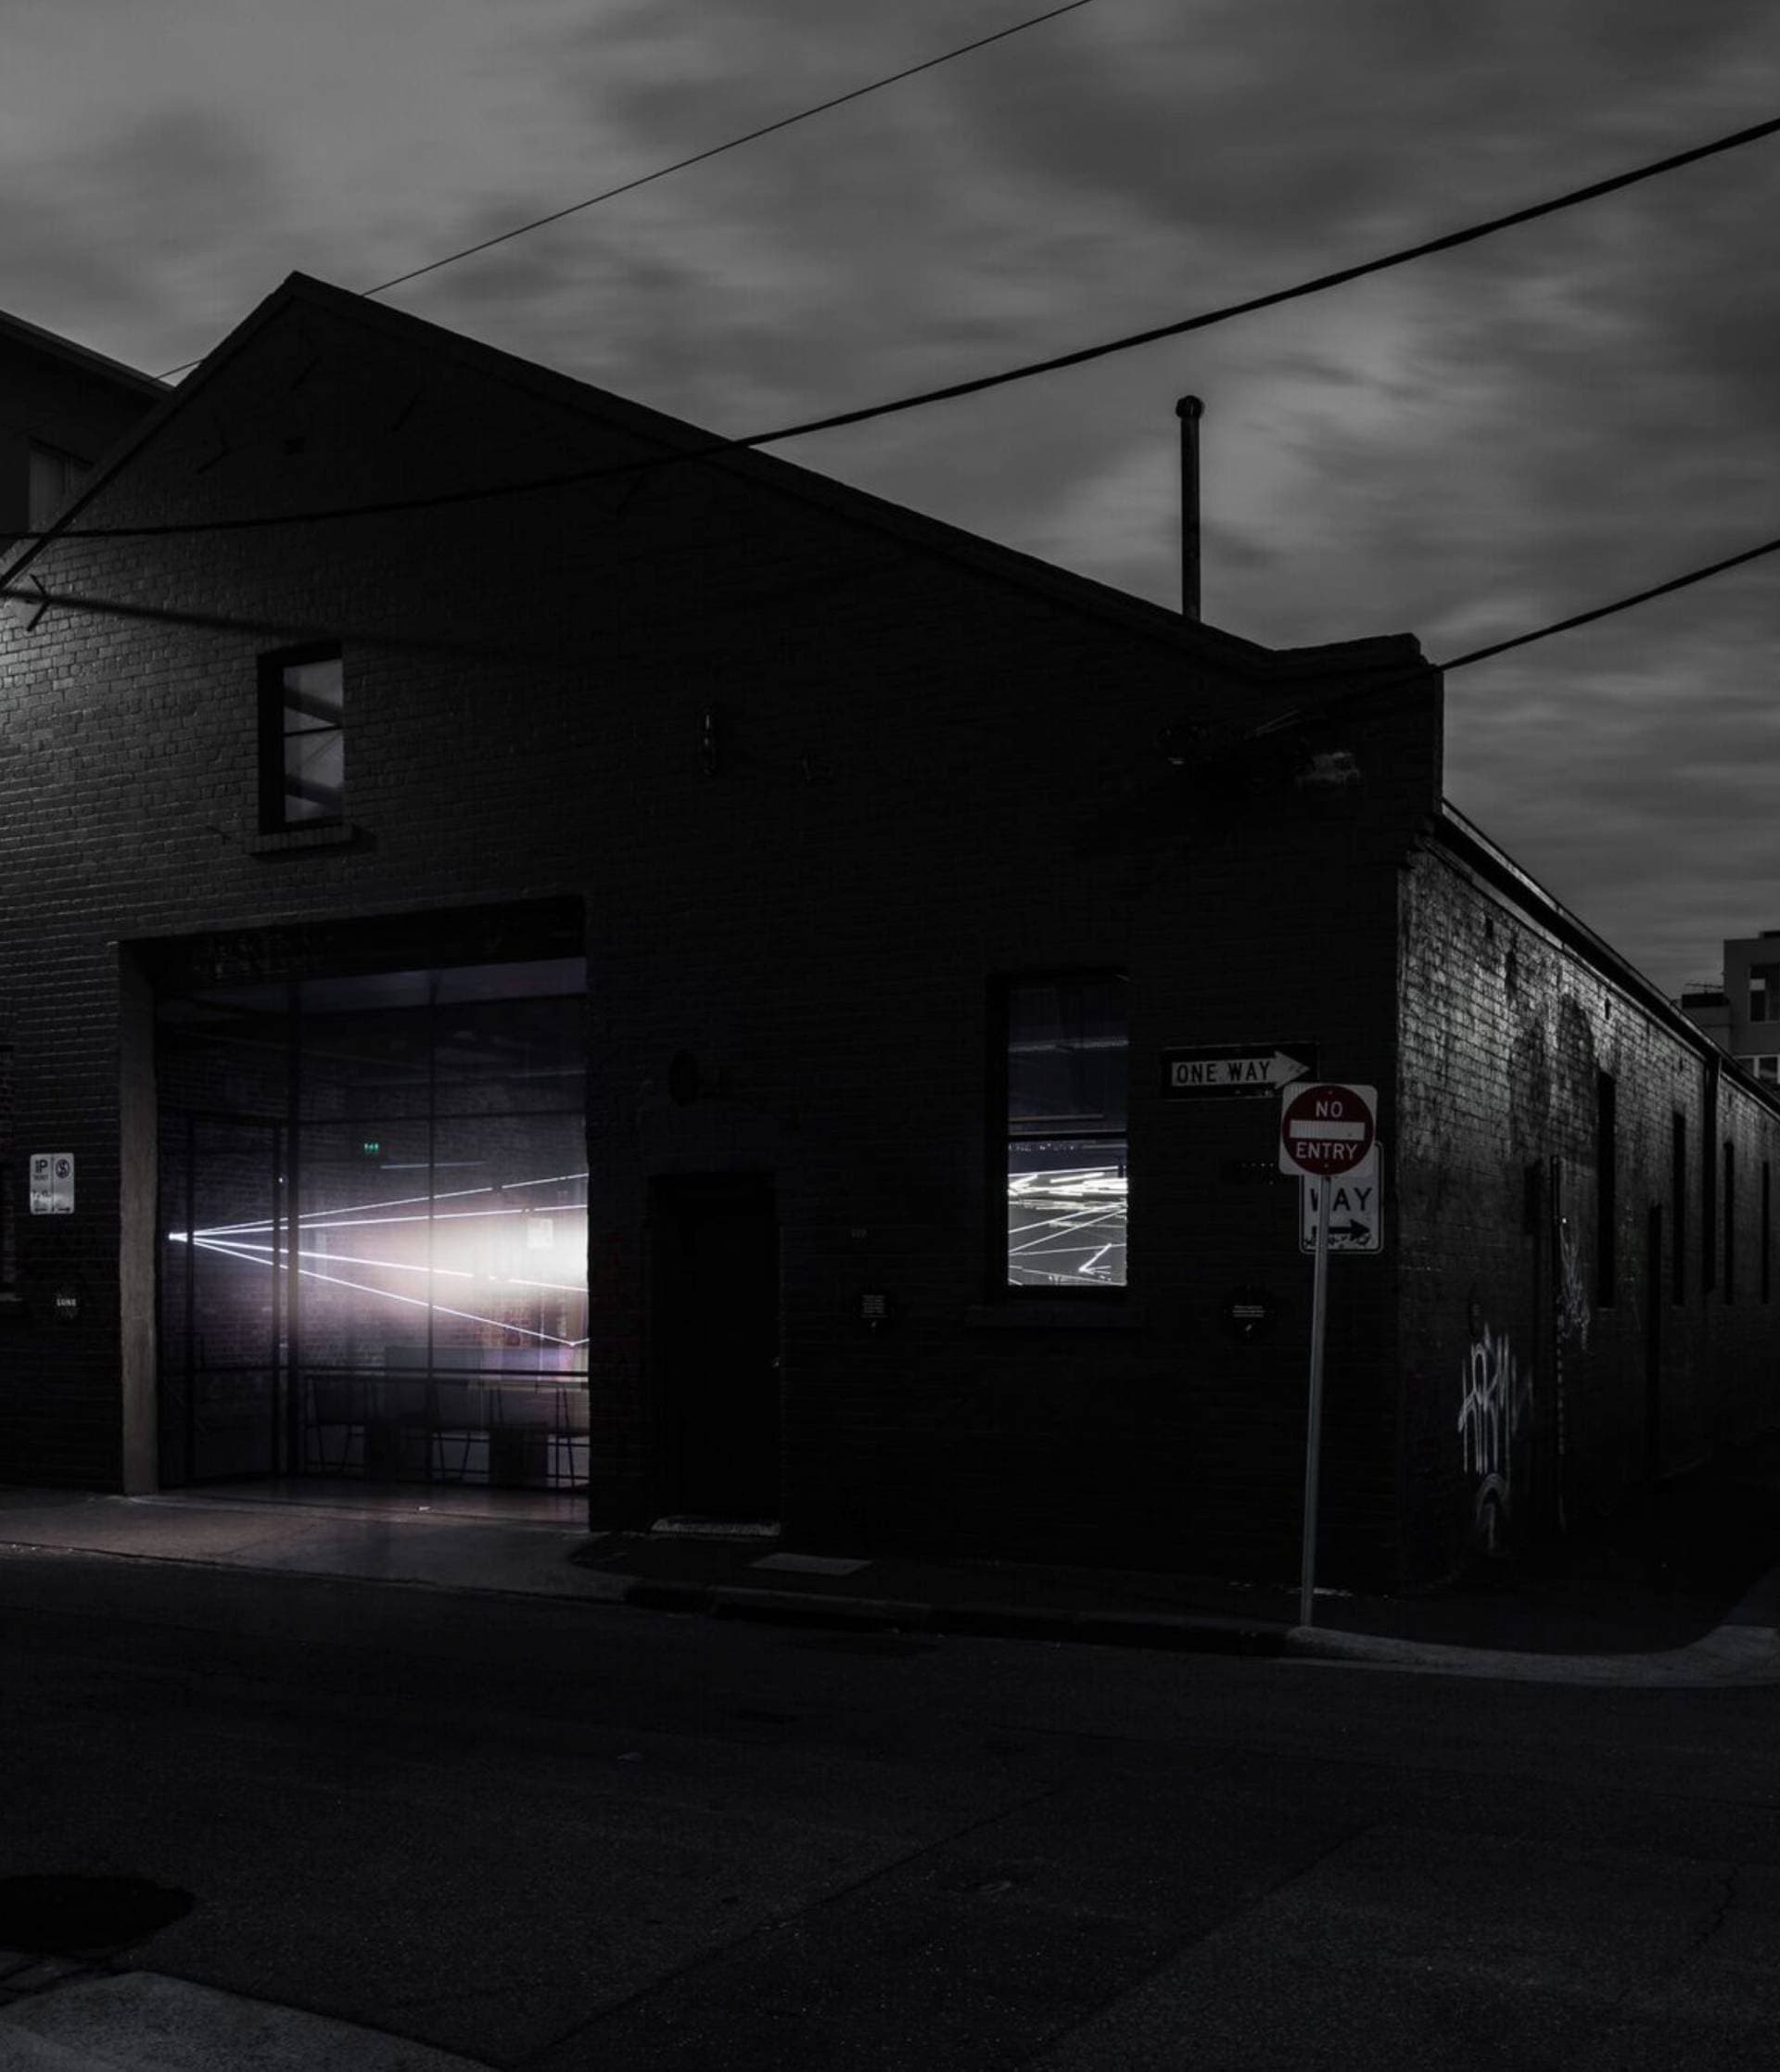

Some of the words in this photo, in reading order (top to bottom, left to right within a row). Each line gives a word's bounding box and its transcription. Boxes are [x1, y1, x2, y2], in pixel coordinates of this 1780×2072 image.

[1176, 1062, 1217, 1084] ONE
[1227, 1060, 1271, 1081] WAY
[1315, 1100, 1343, 1118] NO
[1296, 1141, 1359, 1161] ENTRY
